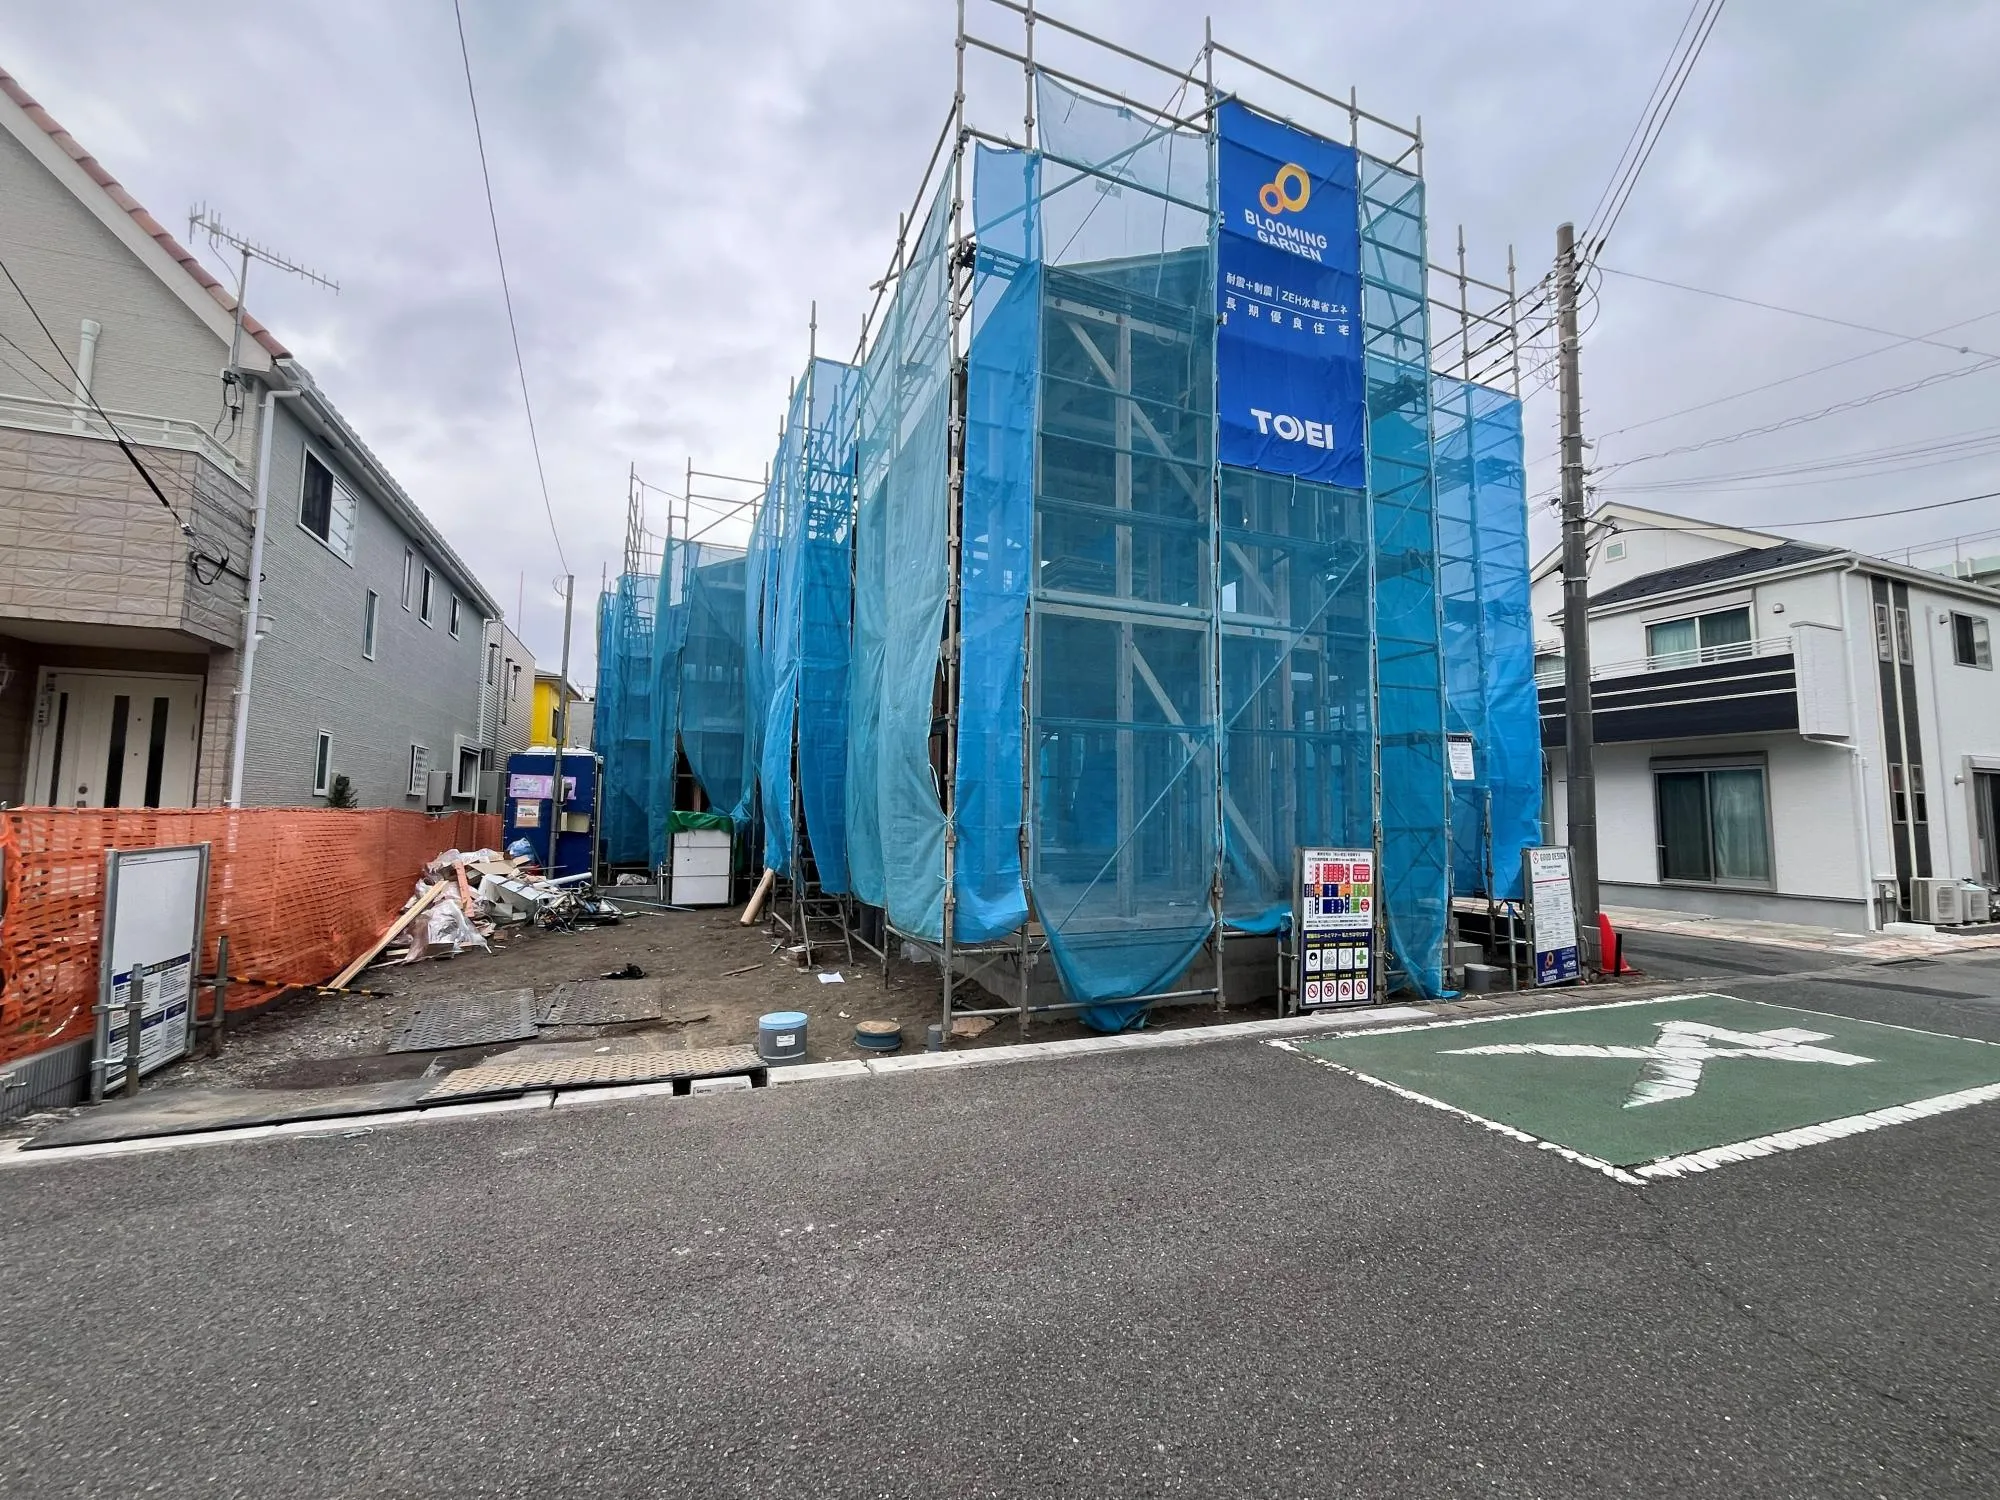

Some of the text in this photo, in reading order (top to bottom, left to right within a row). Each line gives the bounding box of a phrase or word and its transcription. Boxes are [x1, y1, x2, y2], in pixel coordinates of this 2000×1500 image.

[1244, 208, 1328, 249] BLOOMING
[1257, 230, 1323, 263] GARDEN
[1225, 296, 1350, 336] 長期優良住宅
[1250, 408, 1334, 450] TOEI
